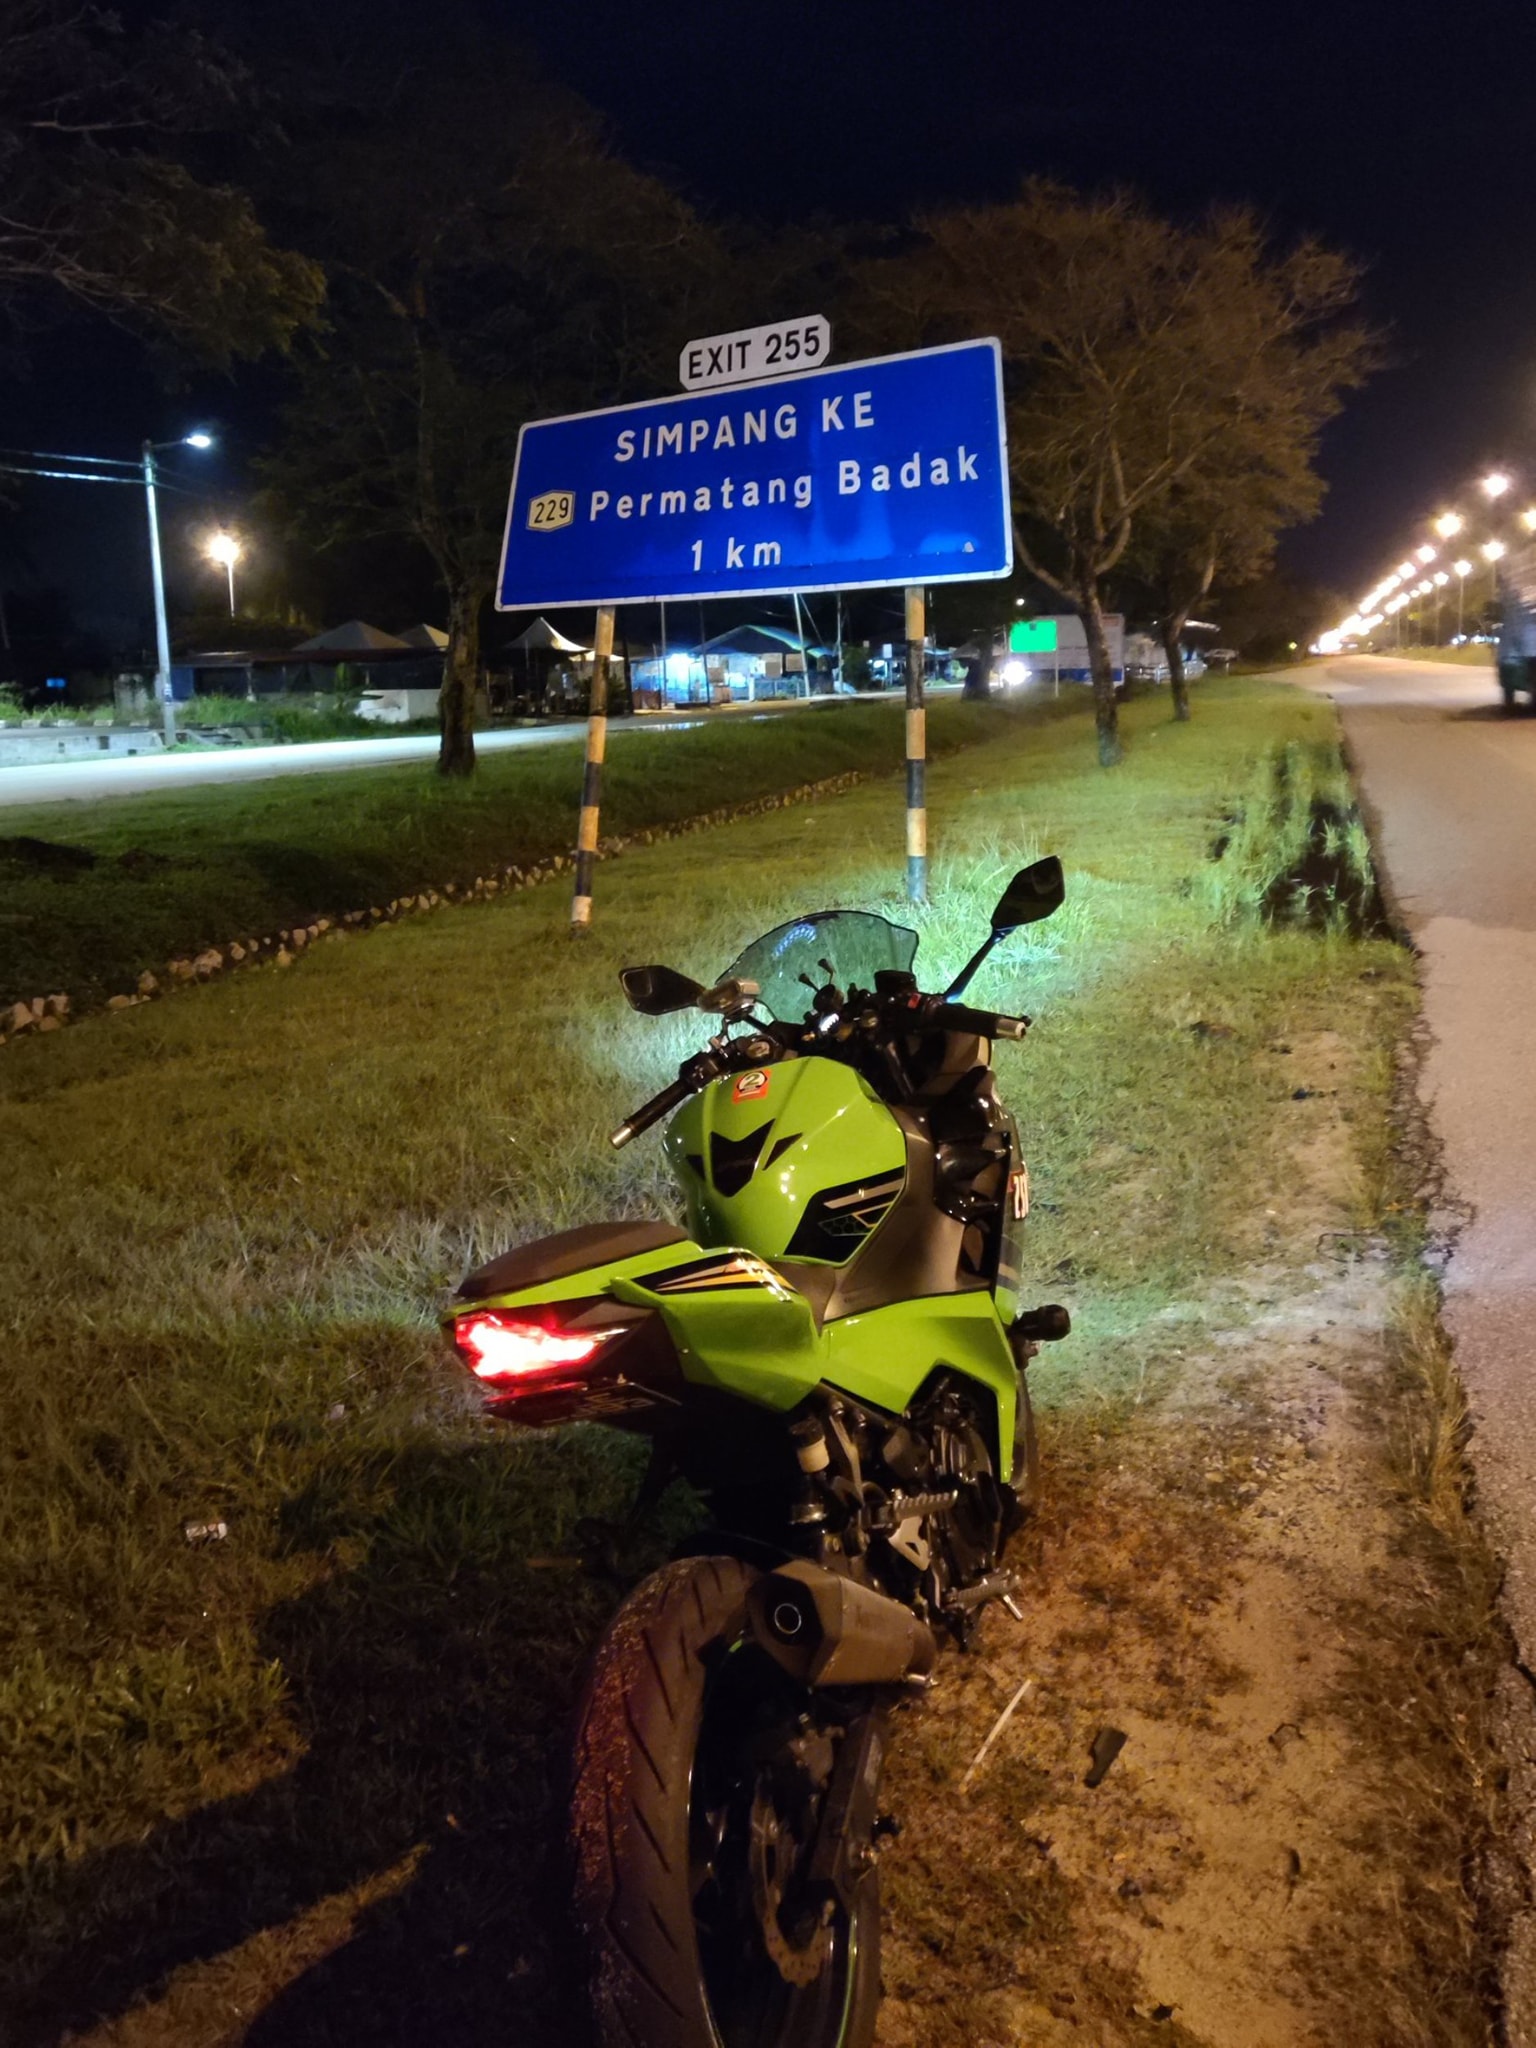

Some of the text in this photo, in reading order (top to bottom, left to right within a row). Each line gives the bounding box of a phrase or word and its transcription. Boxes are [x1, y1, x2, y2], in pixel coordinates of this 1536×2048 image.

[688, 325, 820, 380] EXIT 255
[614, 391, 874, 462] SIMPANG KE
[533, 496, 570, 524] 229
[589, 445, 979, 521] Permatang Badak
[691, 537, 783, 572] 1 km
